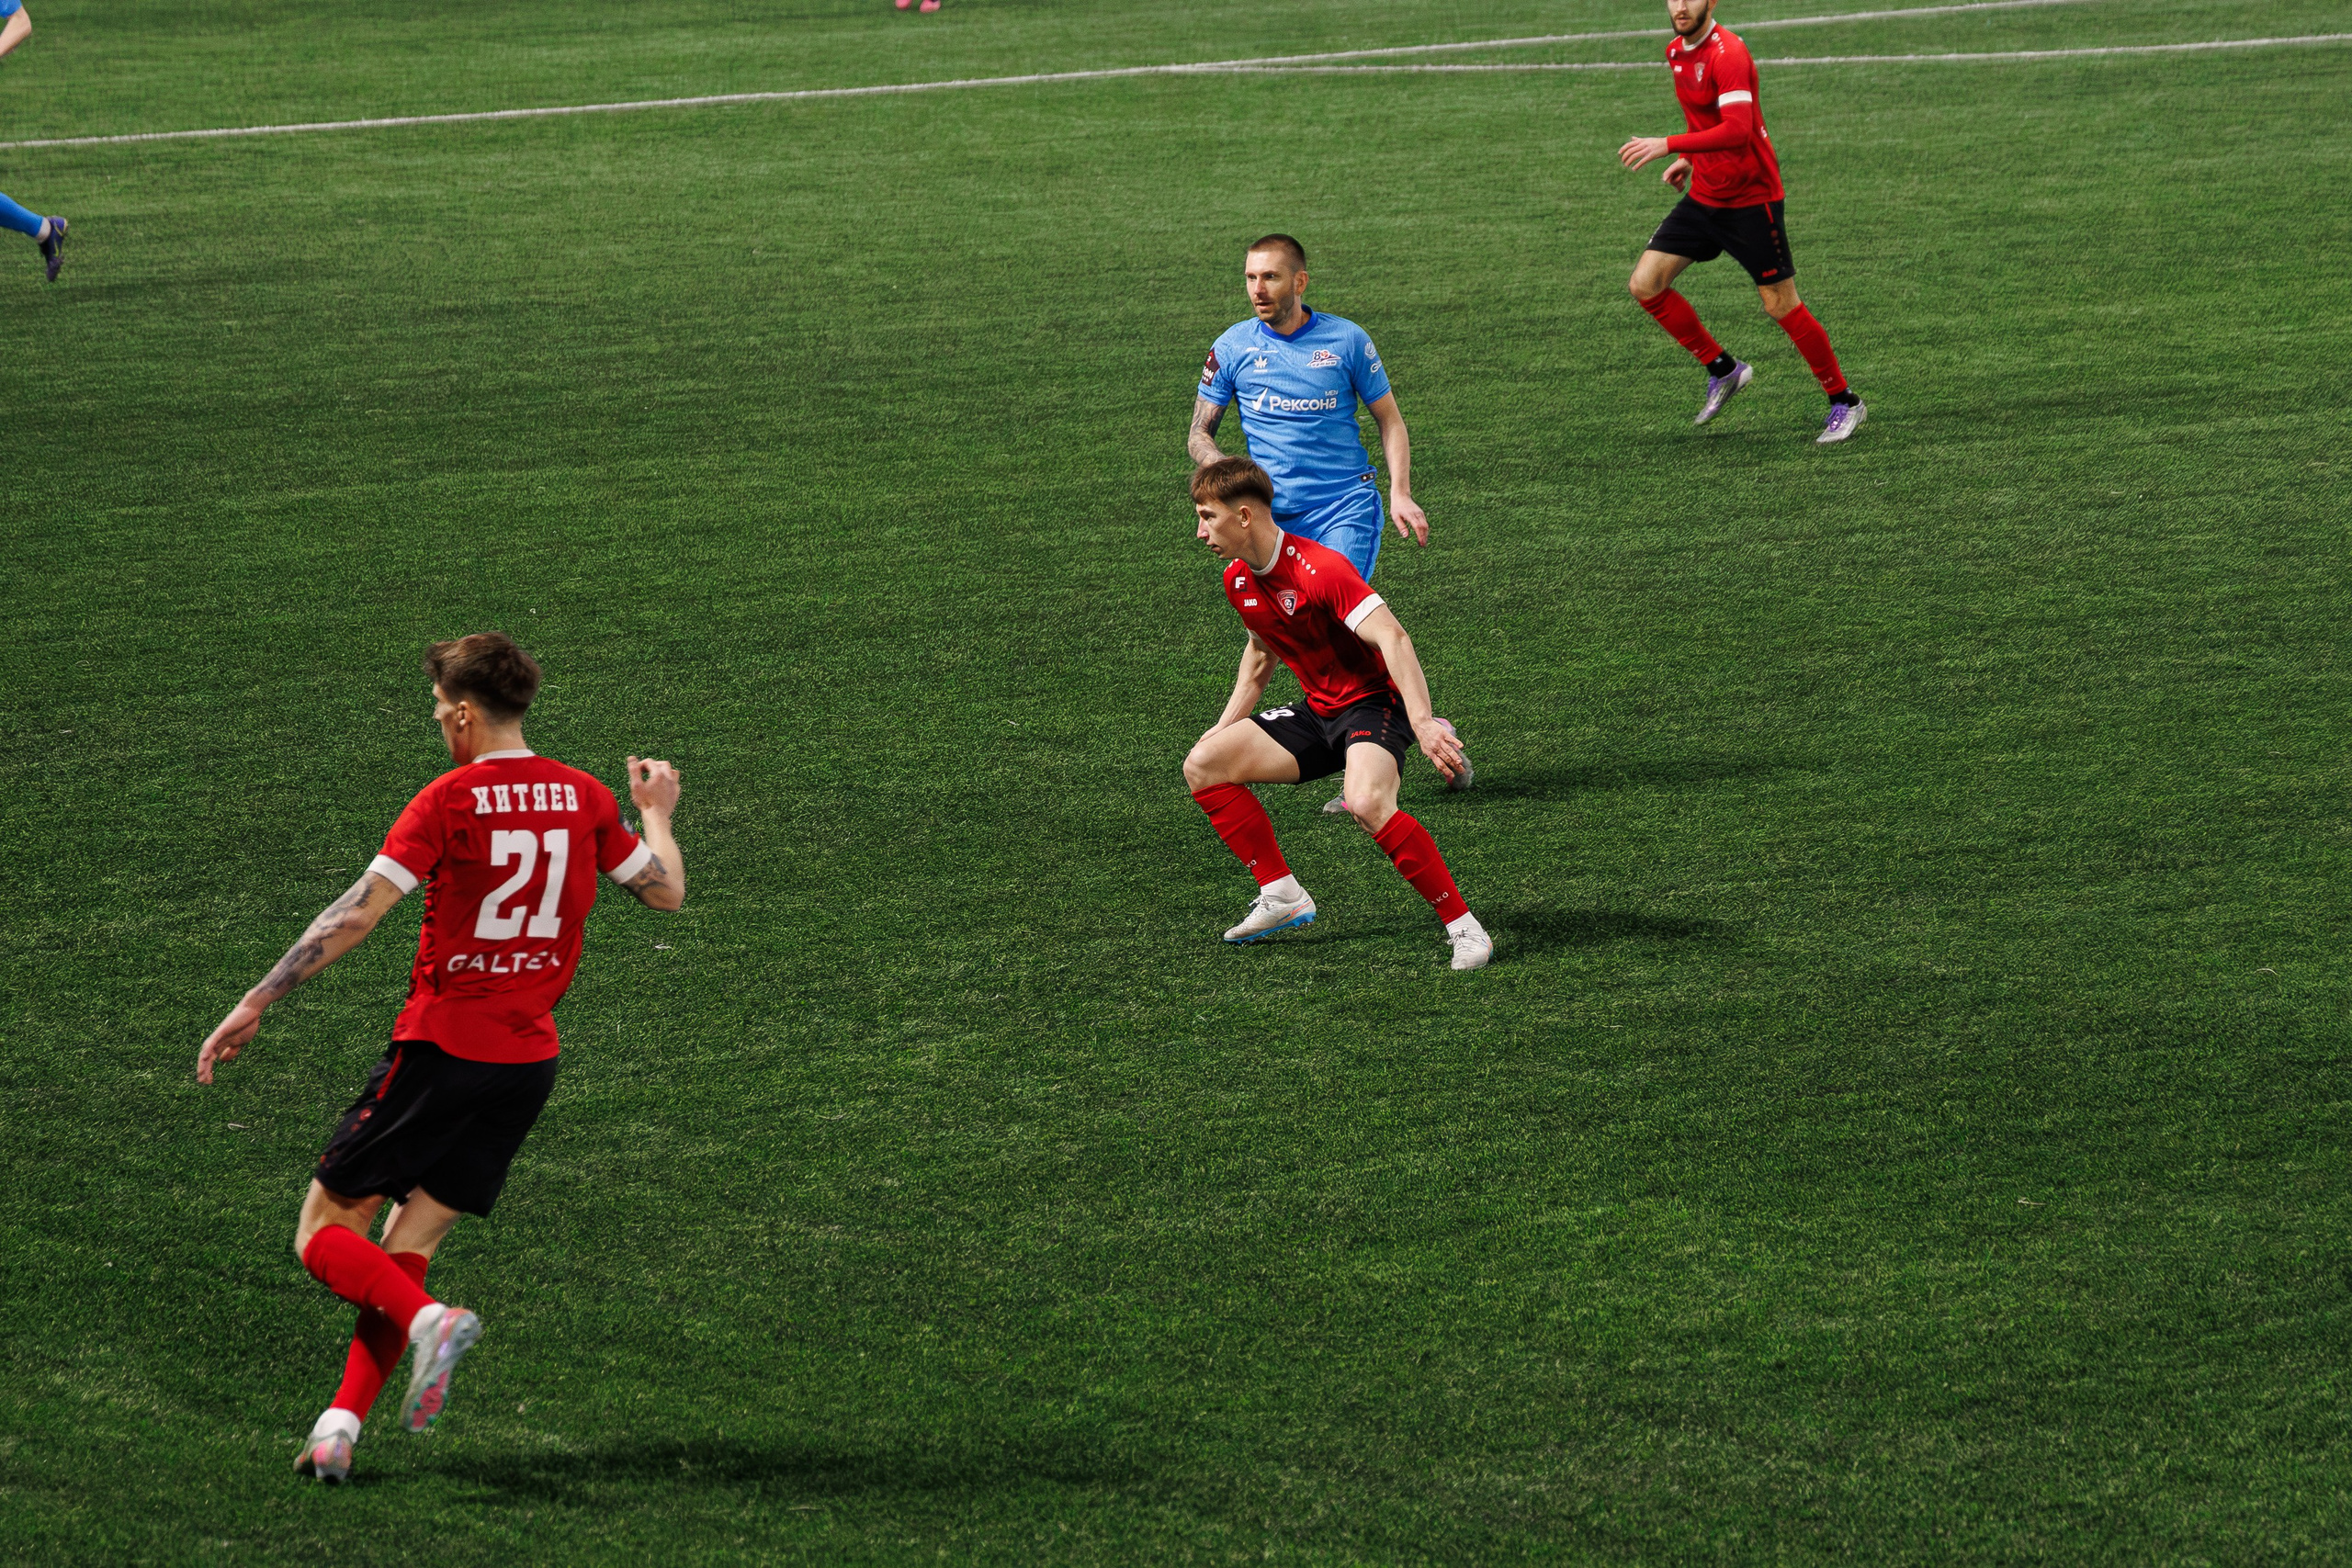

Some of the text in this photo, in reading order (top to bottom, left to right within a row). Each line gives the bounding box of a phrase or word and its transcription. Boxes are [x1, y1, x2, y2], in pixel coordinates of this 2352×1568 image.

[1269, 396, 1337, 412] Рексона
[1243, 598, 1258, 607] JAKO
[1350, 729, 1372, 739] JAKO
[471, 784, 578, 815] ХИТЯЕВ
[474, 829, 569, 940] 21
